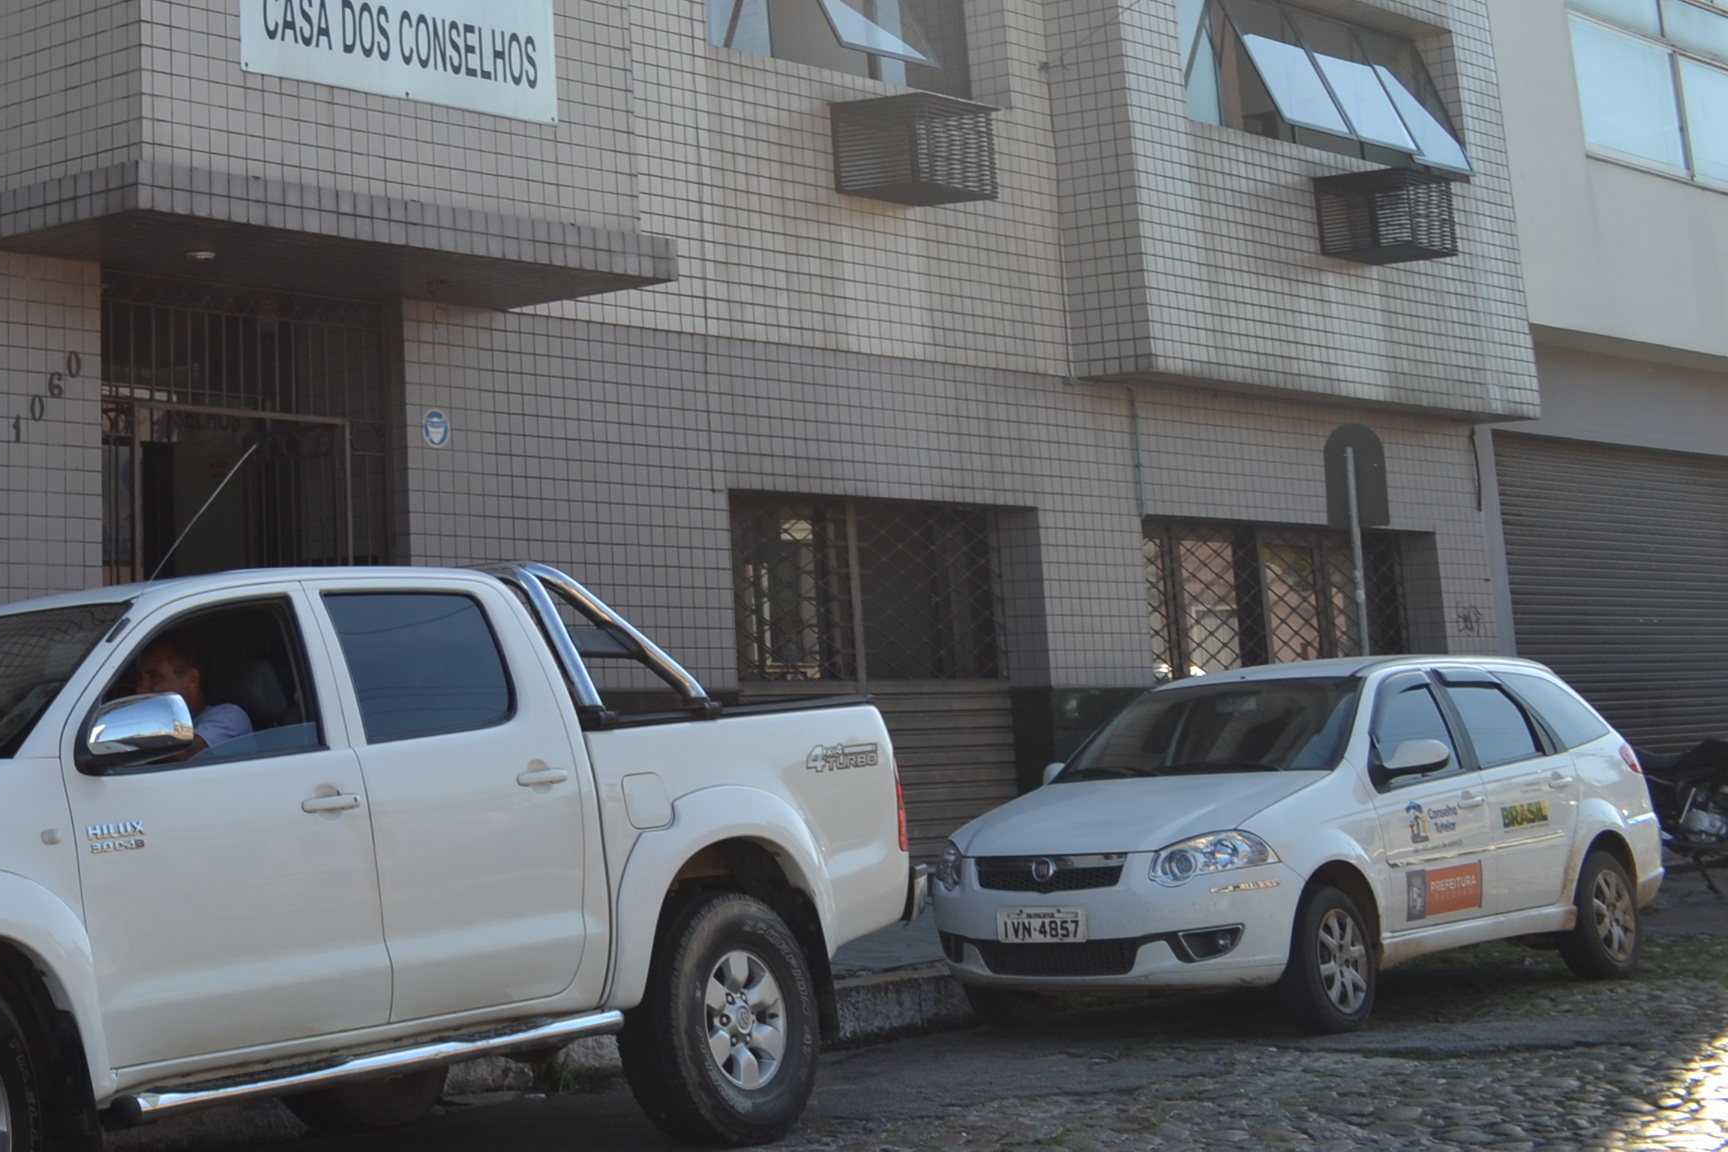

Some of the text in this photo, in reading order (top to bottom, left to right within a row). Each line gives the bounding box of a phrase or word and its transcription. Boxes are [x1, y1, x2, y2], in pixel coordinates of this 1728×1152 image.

[398, 9, 539, 90] CONSELHOS
[12, 351, 82, 444] 1060
[826, 753, 879, 772] TURBO
[1427, 804, 1458, 821] Conselho
[1501, 800, 1549, 829] BRASIL
[86, 820, 146, 841] HILUX
[1430, 874, 1477, 893] PREFEITURA
